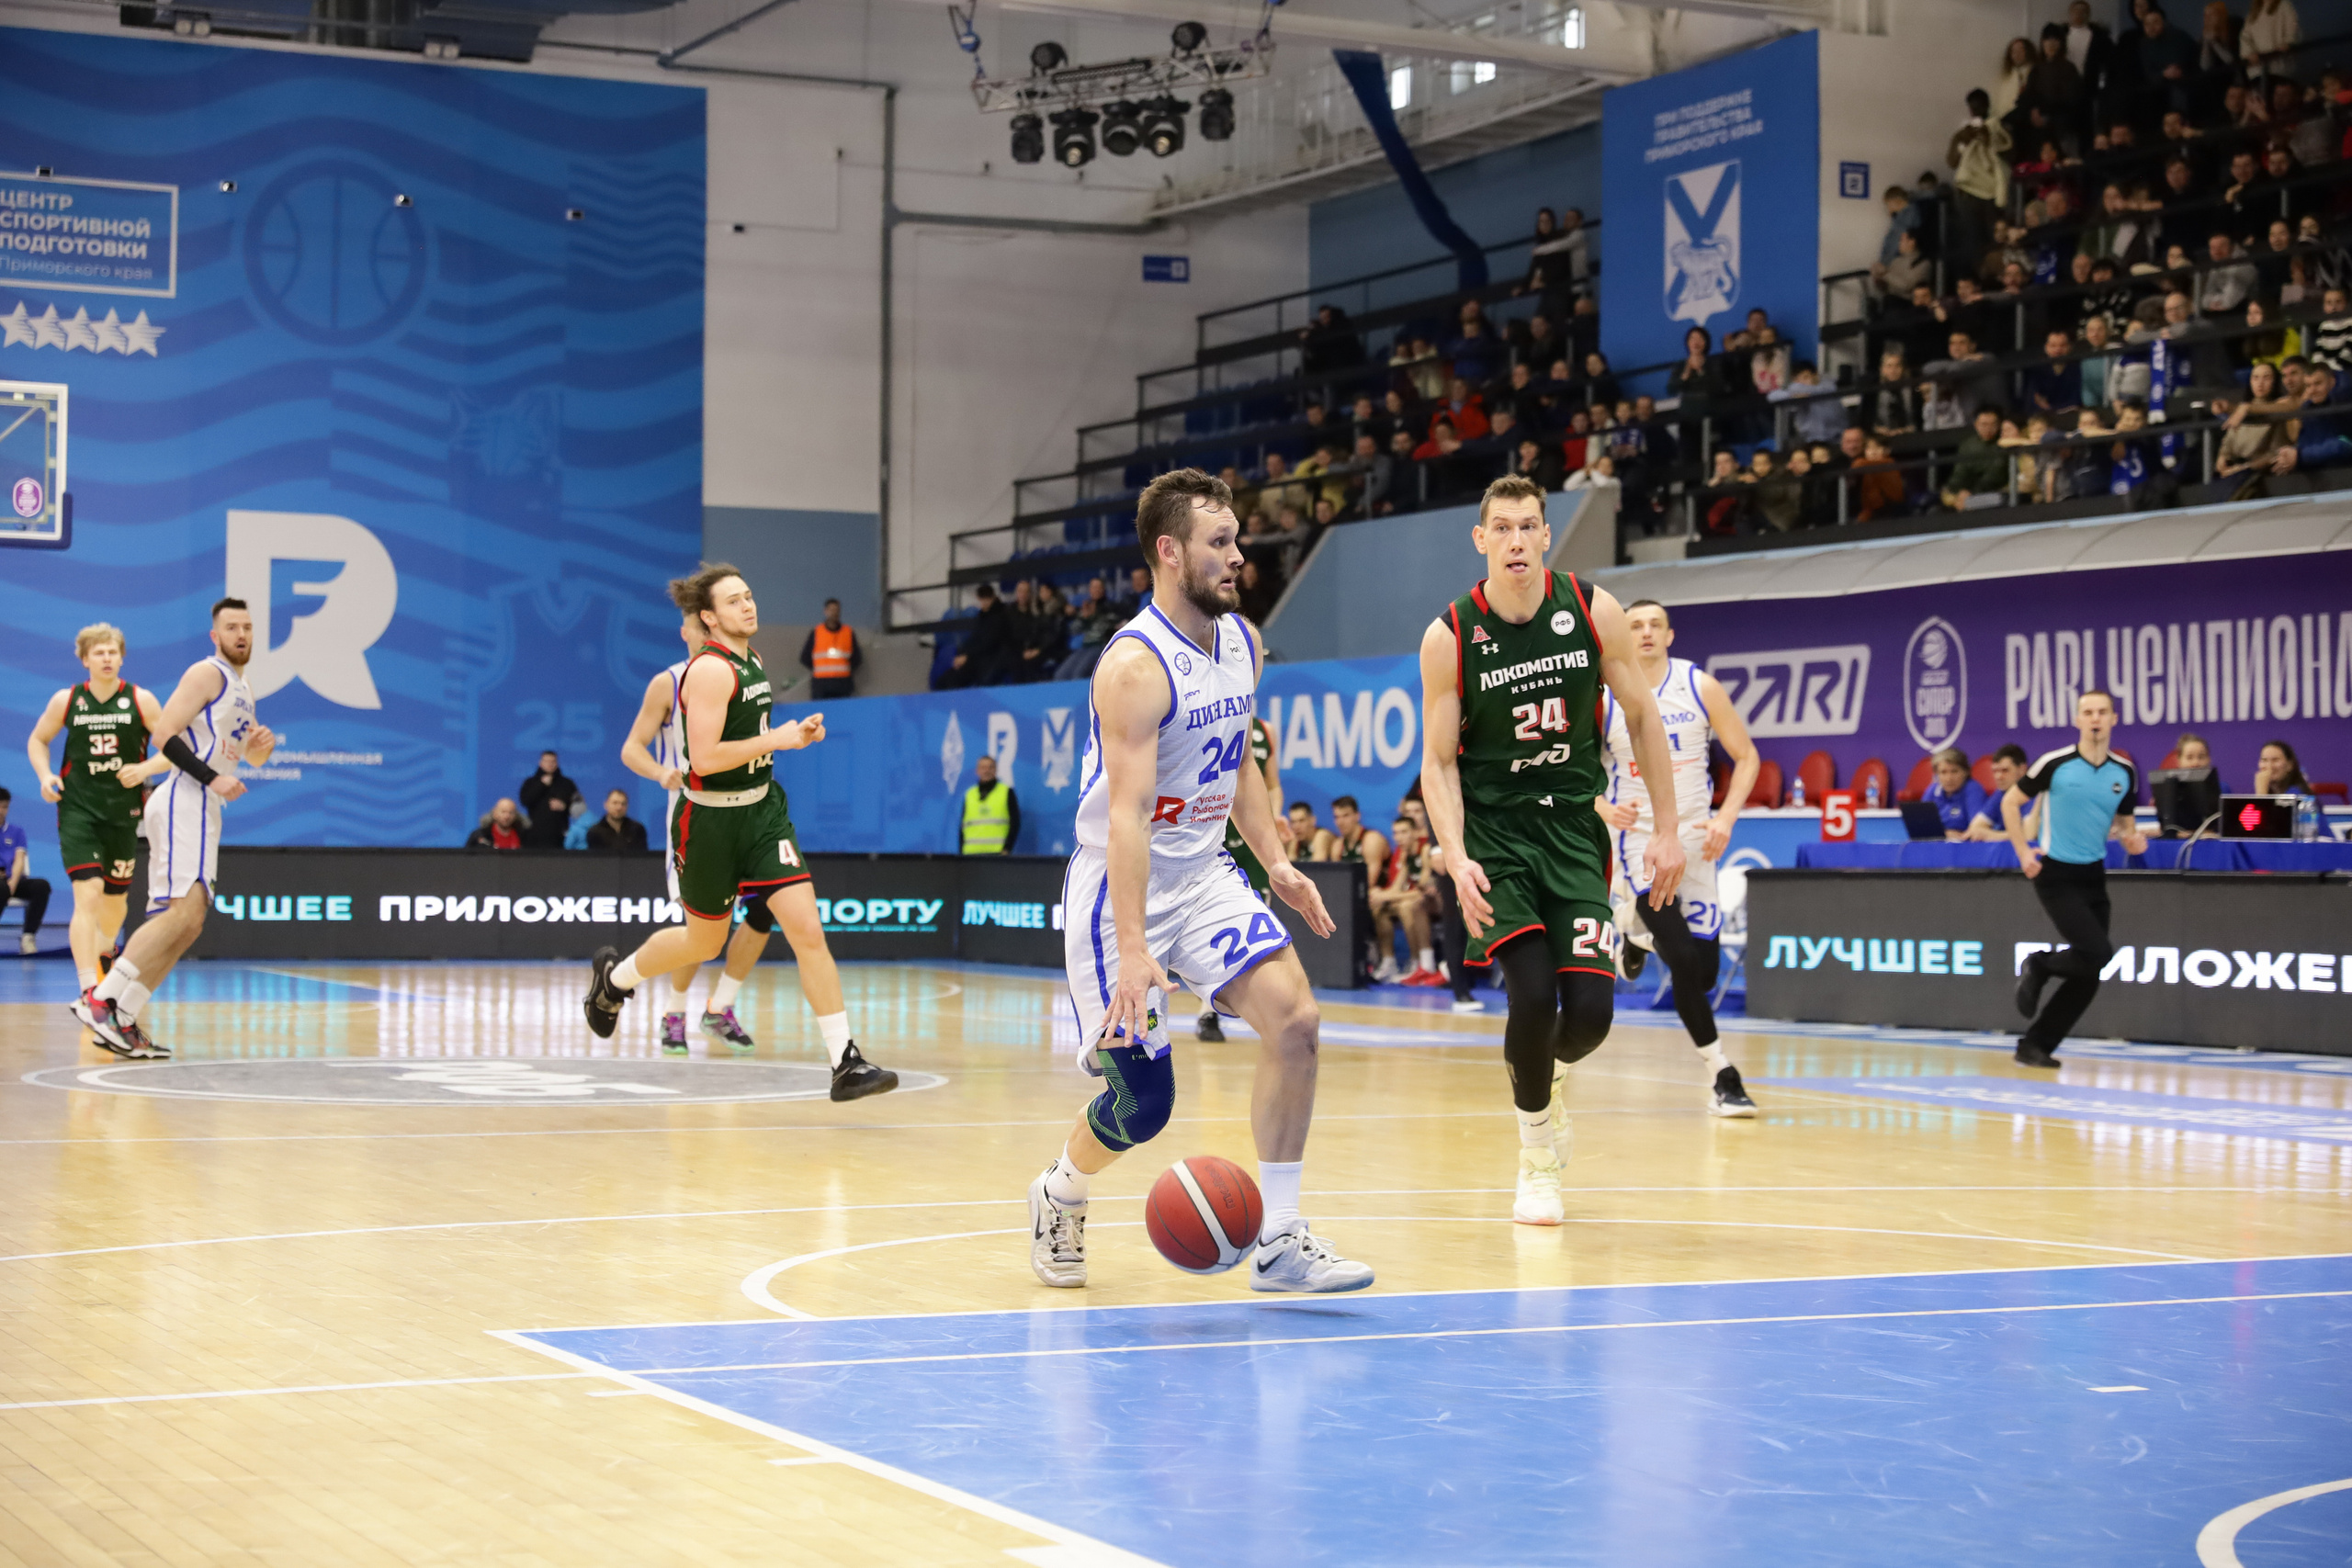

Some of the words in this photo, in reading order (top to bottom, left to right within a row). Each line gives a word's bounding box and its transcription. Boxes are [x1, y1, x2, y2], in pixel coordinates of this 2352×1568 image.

[0, 189, 74, 211] ЦЕНТР
[0, 211, 151, 239] СПОРТИВНОЙ
[0, 231, 148, 260] ПОДГОТОВКИ
[0, 254, 111, 278] Приморского
[114, 265, 153, 280] края
[1479, 649, 1589, 692] ЛОКОМОТИВ
[1510, 676, 1563, 694] КУБАНЬ
[513, 699, 605, 752] 25
[1186, 693, 1254, 731] ДИНАМ
[1512, 696, 1571, 741] 24
[89, 734, 119, 756] 32
[1198, 729, 1246, 785] 24
[1825, 795, 1853, 838] 5
[111, 857, 136, 878] 32
[779, 839, 800, 867] 4
[214, 895, 353, 921] ЧШЕЕ
[379, 895, 684, 923] ПРИЛОЖЕНИ
[816, 898, 944, 924] ПОРТУ
[961, 899, 1046, 930] ЛУЧШЕЕ
[1686, 900, 1717, 929] 21
[1210, 912, 1283, 970] 24
[1572, 917, 1615, 963] 24
[1763, 935, 1984, 976] ЛУЧШЕЕ
